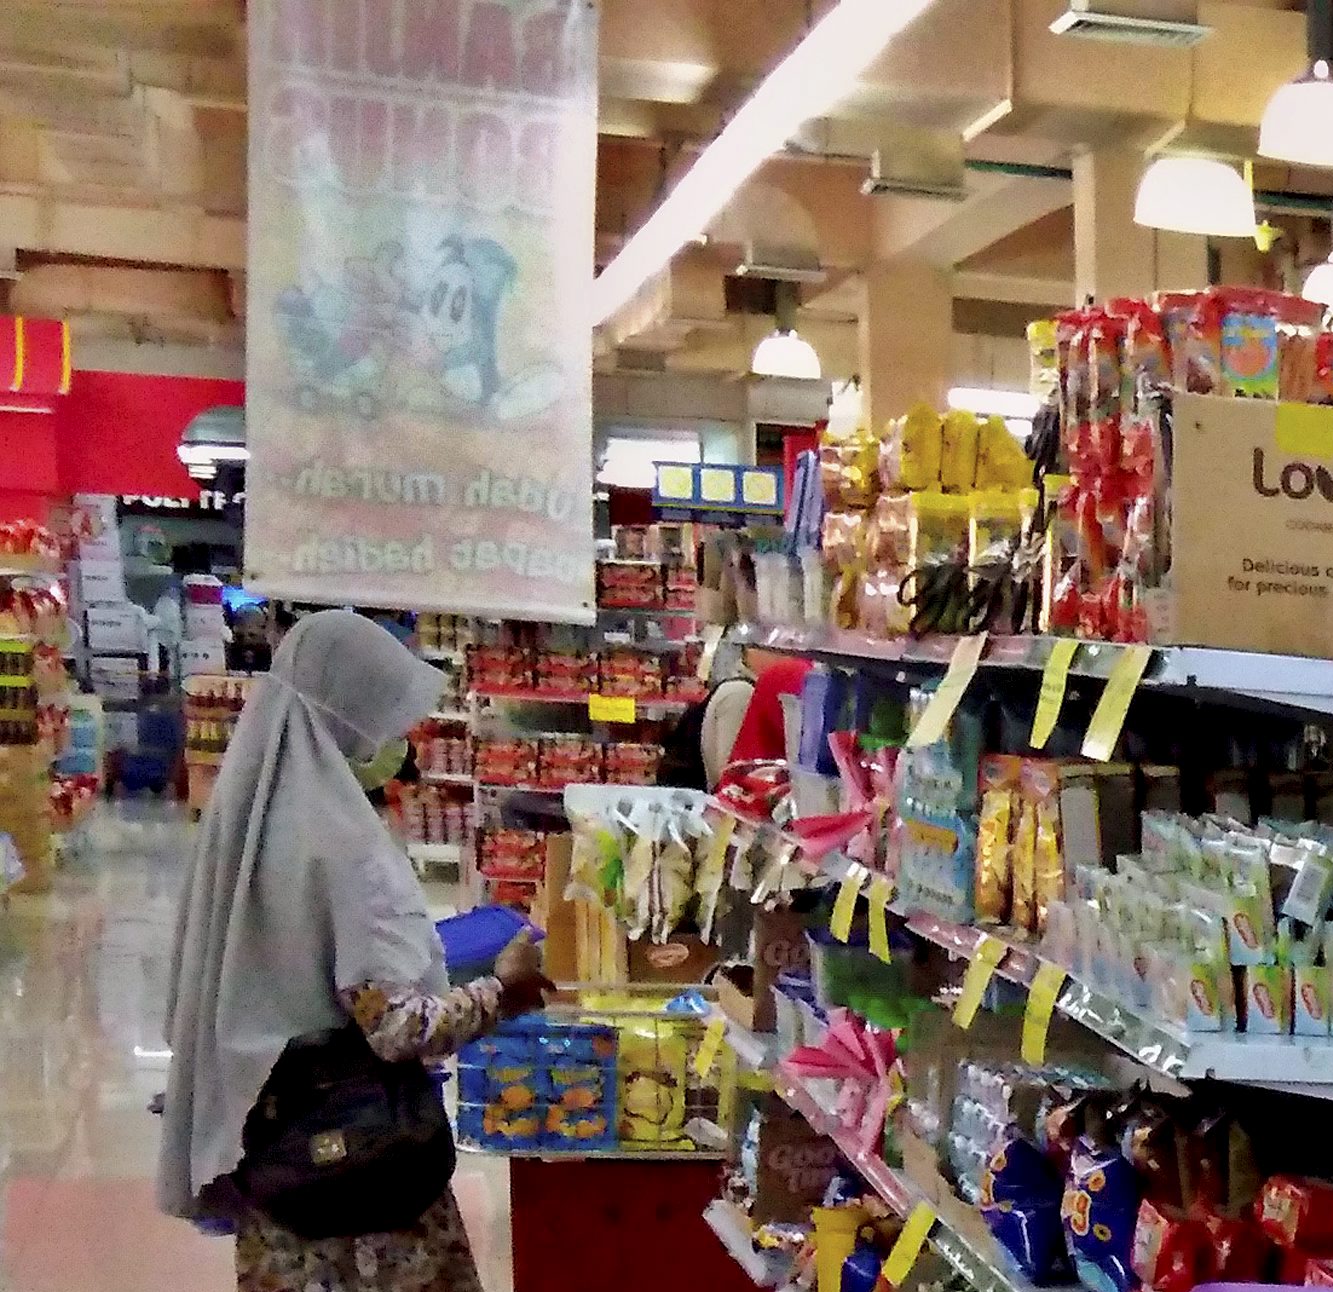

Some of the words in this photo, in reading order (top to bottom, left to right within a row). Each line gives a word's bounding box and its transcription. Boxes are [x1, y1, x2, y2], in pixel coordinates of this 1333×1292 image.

[1242, 558, 1320, 578] Delicious
[1228, 575, 1251, 592] for
[1256, 580, 1328, 597] precious
